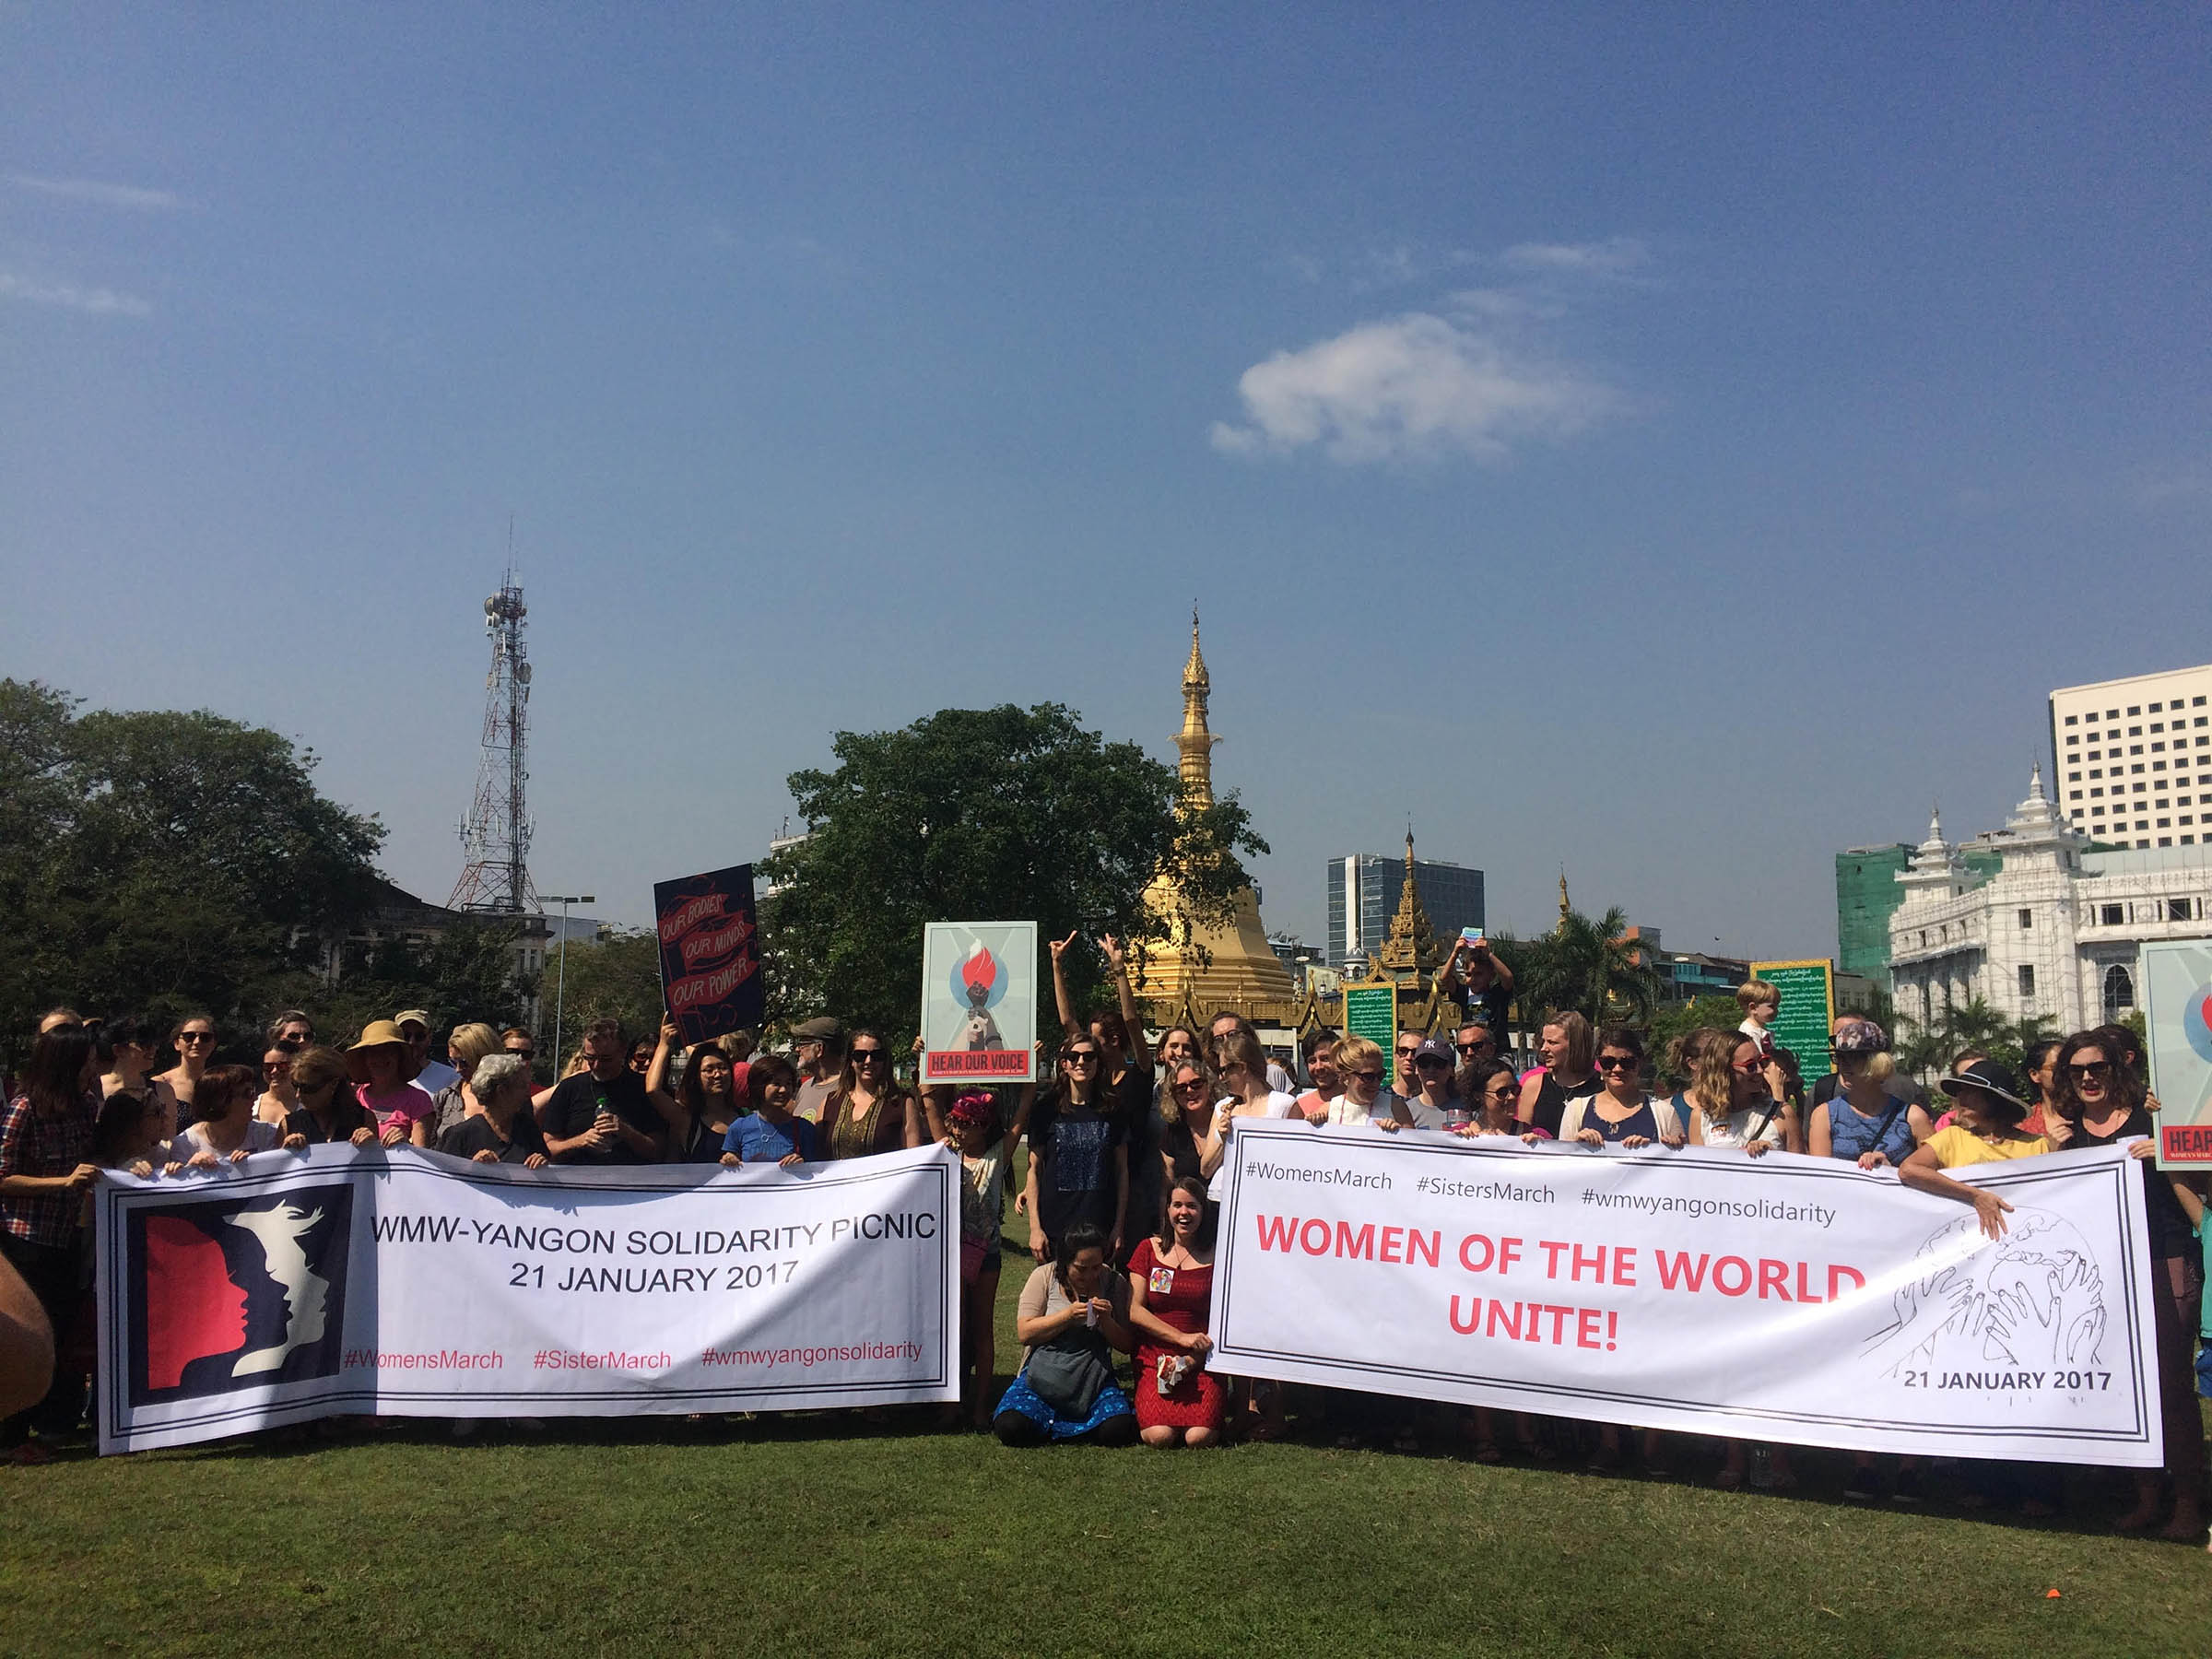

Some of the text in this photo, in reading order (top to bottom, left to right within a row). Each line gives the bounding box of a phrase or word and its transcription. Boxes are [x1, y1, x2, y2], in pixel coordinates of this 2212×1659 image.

[662, 893, 723, 940] OUR BODIES
[685, 922, 745, 959] OUR MINDS
[673, 957, 747, 1006] OUR POWER
[932, 1053, 1024, 1071] HEAR OUR VOICE
[1246, 1161, 1836, 1229] #WomensMarch #SistersMarch #wmwyangonsolidarity
[371, 1212, 936, 1255] WMW-YANGON SOLIDARITY PICNIC
[510, 1260, 799, 1292] 21 JANUARY 2017
[1256, 1214, 1866, 1304] WOMEN OF THE WORLD
[1449, 1294, 1618, 1351] UNITE!
[344, 1341, 923, 1370] #WomensMarch #SisterMarch #wmwyangonsolidarity
[1904, 1371, 2112, 1391] 21 JANUARY 2017
